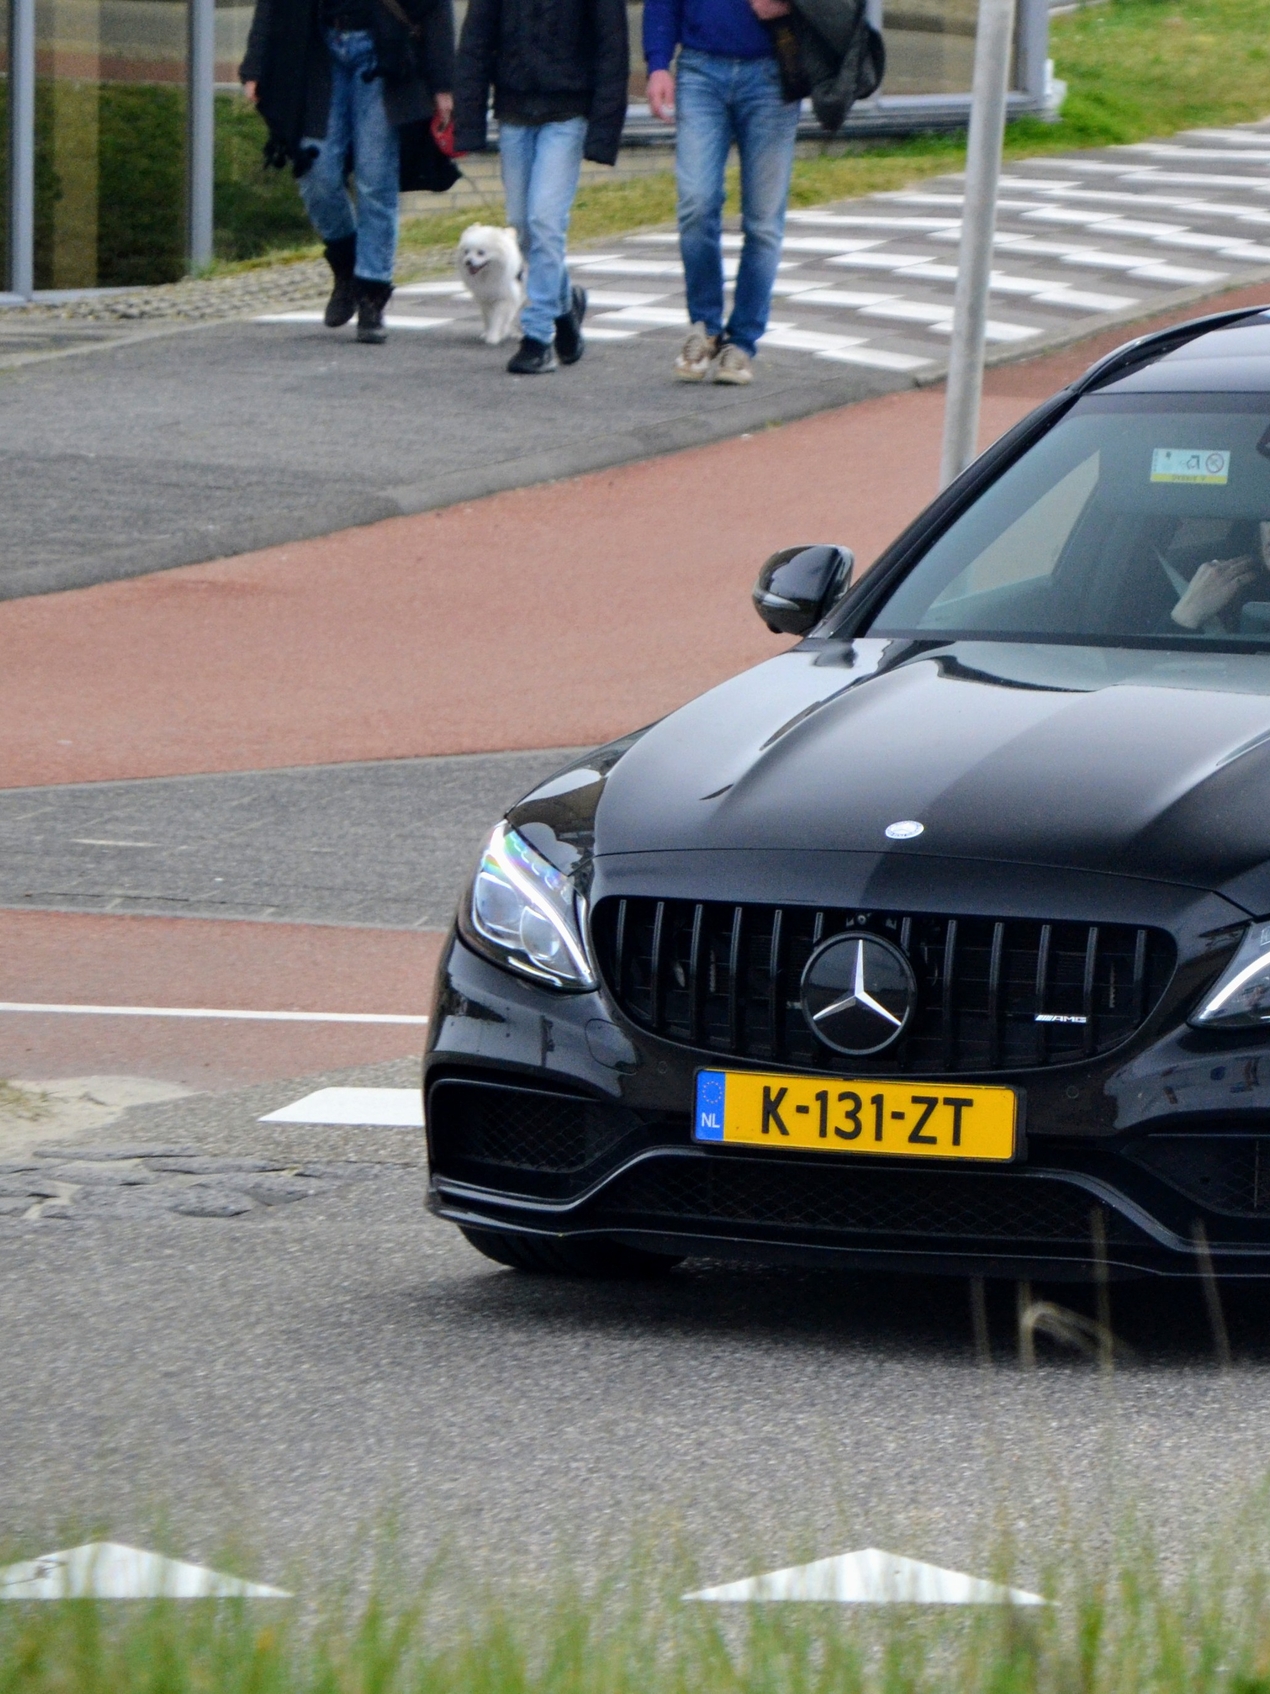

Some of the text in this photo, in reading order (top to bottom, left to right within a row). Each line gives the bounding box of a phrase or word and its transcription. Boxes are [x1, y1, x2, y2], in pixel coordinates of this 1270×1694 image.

[1051, 1014, 1087, 1023] AMG
[701, 1112, 720, 1128] NL
[761, 1085, 974, 1147] K-131-ZT
